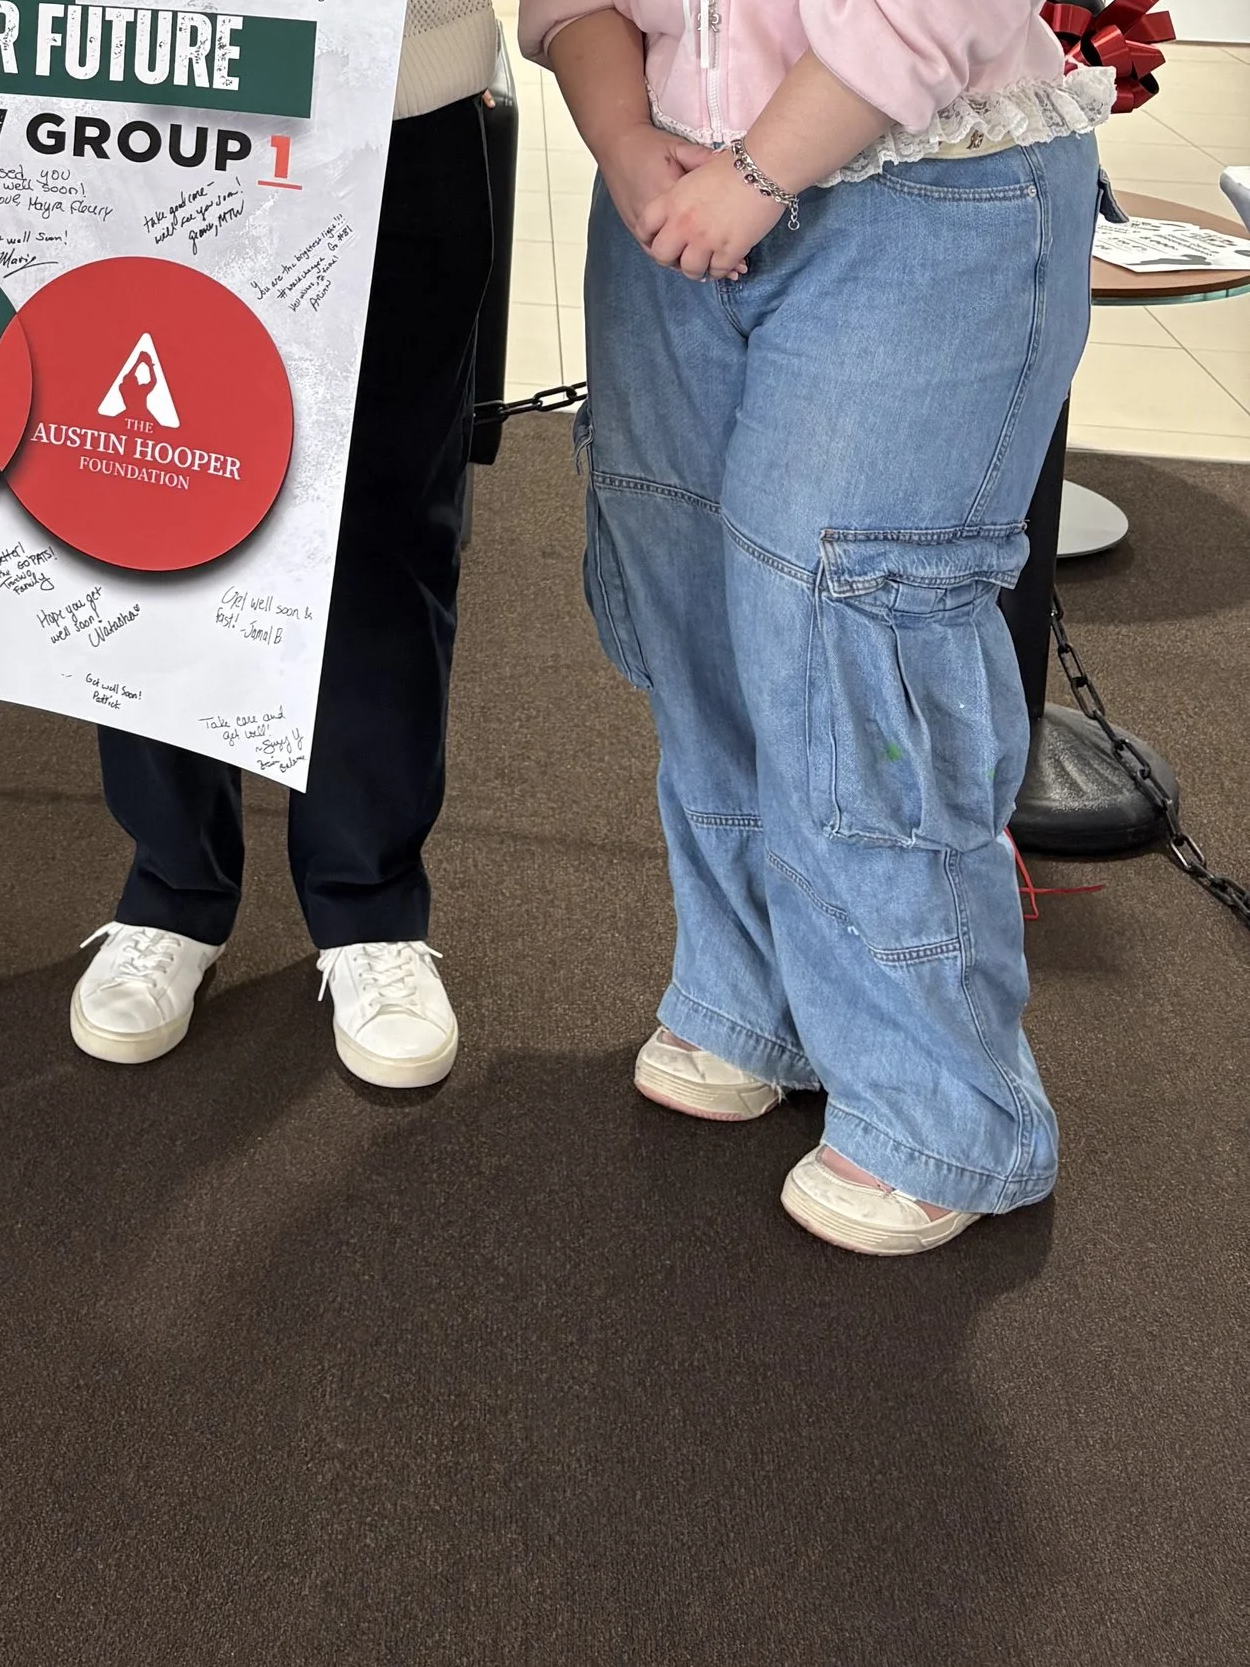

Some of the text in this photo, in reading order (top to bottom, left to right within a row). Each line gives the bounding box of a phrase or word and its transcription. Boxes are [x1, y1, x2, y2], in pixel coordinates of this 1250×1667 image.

[35, 6, 244, 92] FUTURE
[26, 113, 252, 172] GROUP
[4, 179, 33, 191] well
[37, 169, 71, 187] you
[196, 200, 213, 221] you
[7, 231, 31, 244] well
[271, 276, 283, 287] are
[282, 264, 297, 275] the
[125, 418, 153, 434] THE
[31, 422, 241, 480] AUSTIN HOOPER
[79, 456, 190, 490] FOUNDATION
[37, 587, 103, 628] Hope you get
[251, 597, 272, 612] well
[51, 626, 71, 644] well
[89, 610, 138, 647] Natasha
[274, 628, 282, 644] B
[86, 673, 101, 687] Get
[199, 706, 285, 729] Take care and
